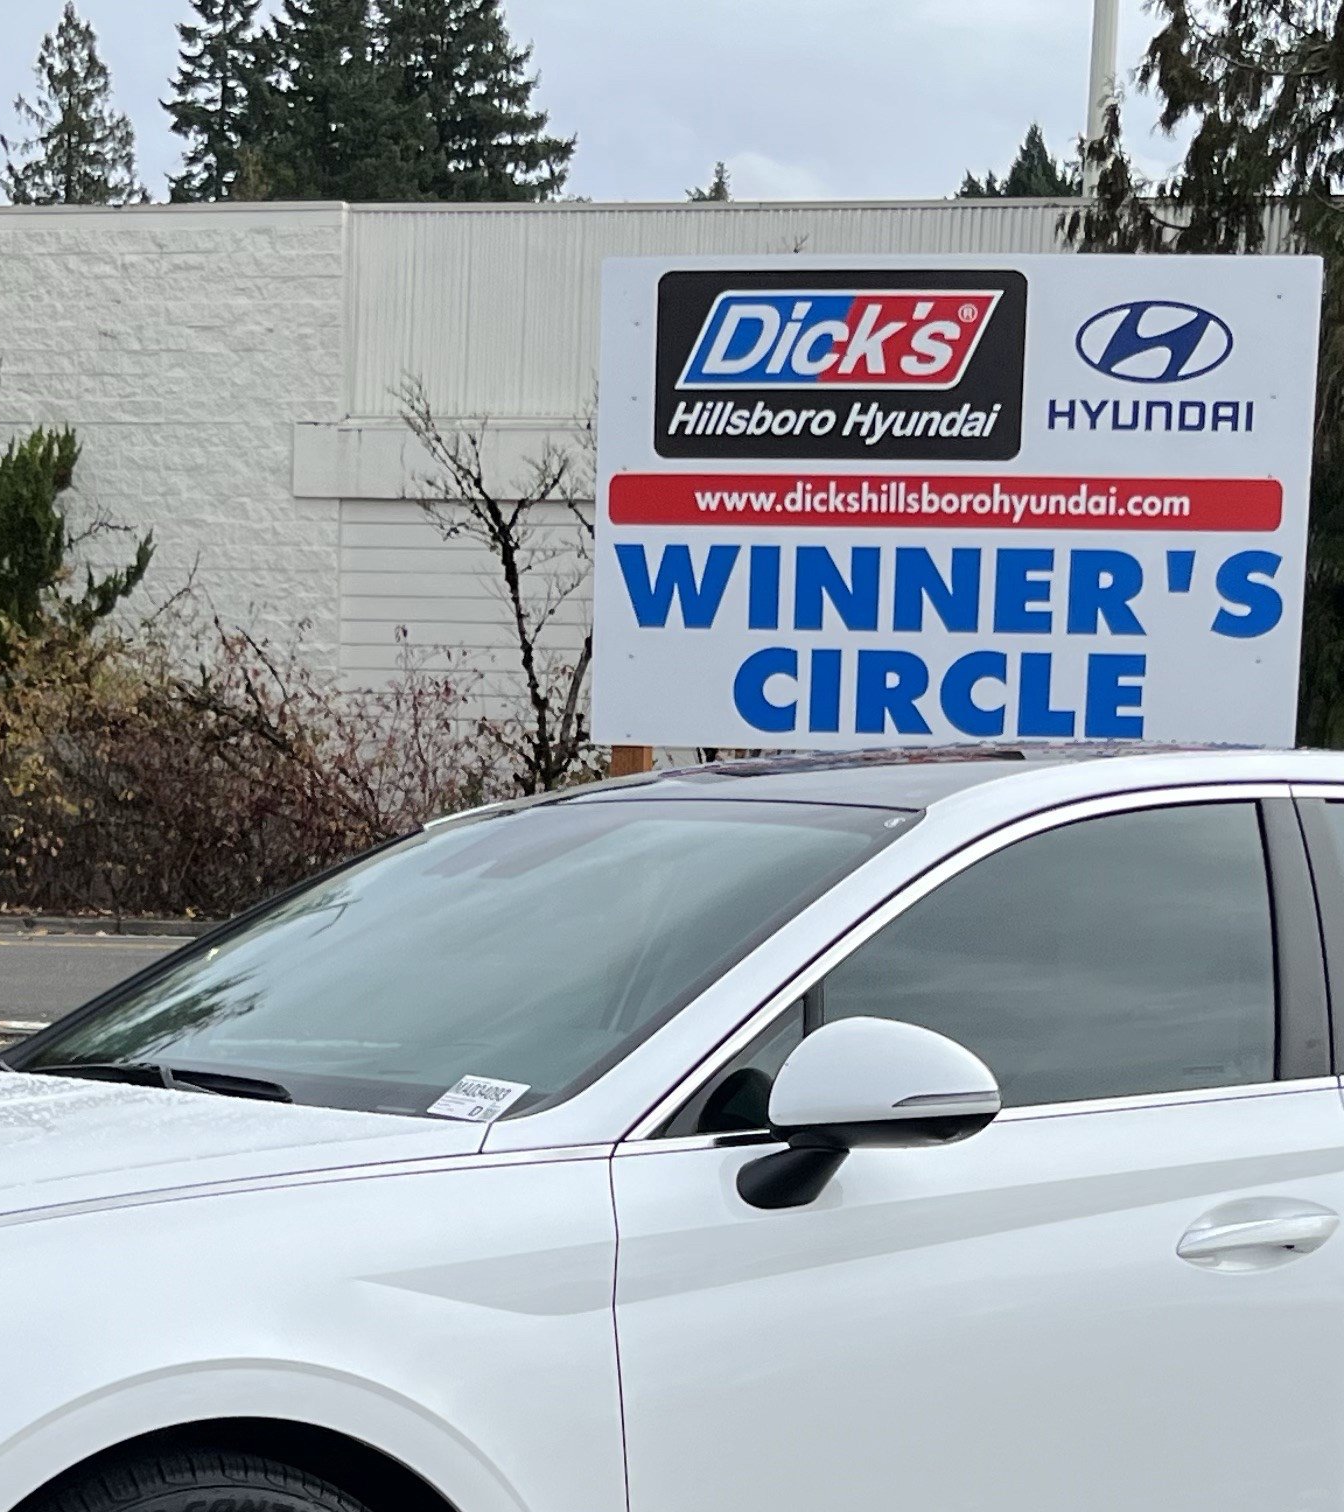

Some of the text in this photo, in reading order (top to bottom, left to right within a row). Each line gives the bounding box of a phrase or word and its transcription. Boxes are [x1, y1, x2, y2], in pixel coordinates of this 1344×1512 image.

[701, 301, 961, 377] Dick's
[667, 401, 1002, 445] Hillsboro Hyundai
[1048, 399, 1254, 432] HYUNDAI
[694, 482, 1190, 524] www.dickshillsborohyundai.com
[613, 543, 1283, 639] WINNER'S
[733, 647, 1147, 739] CIRCLE
